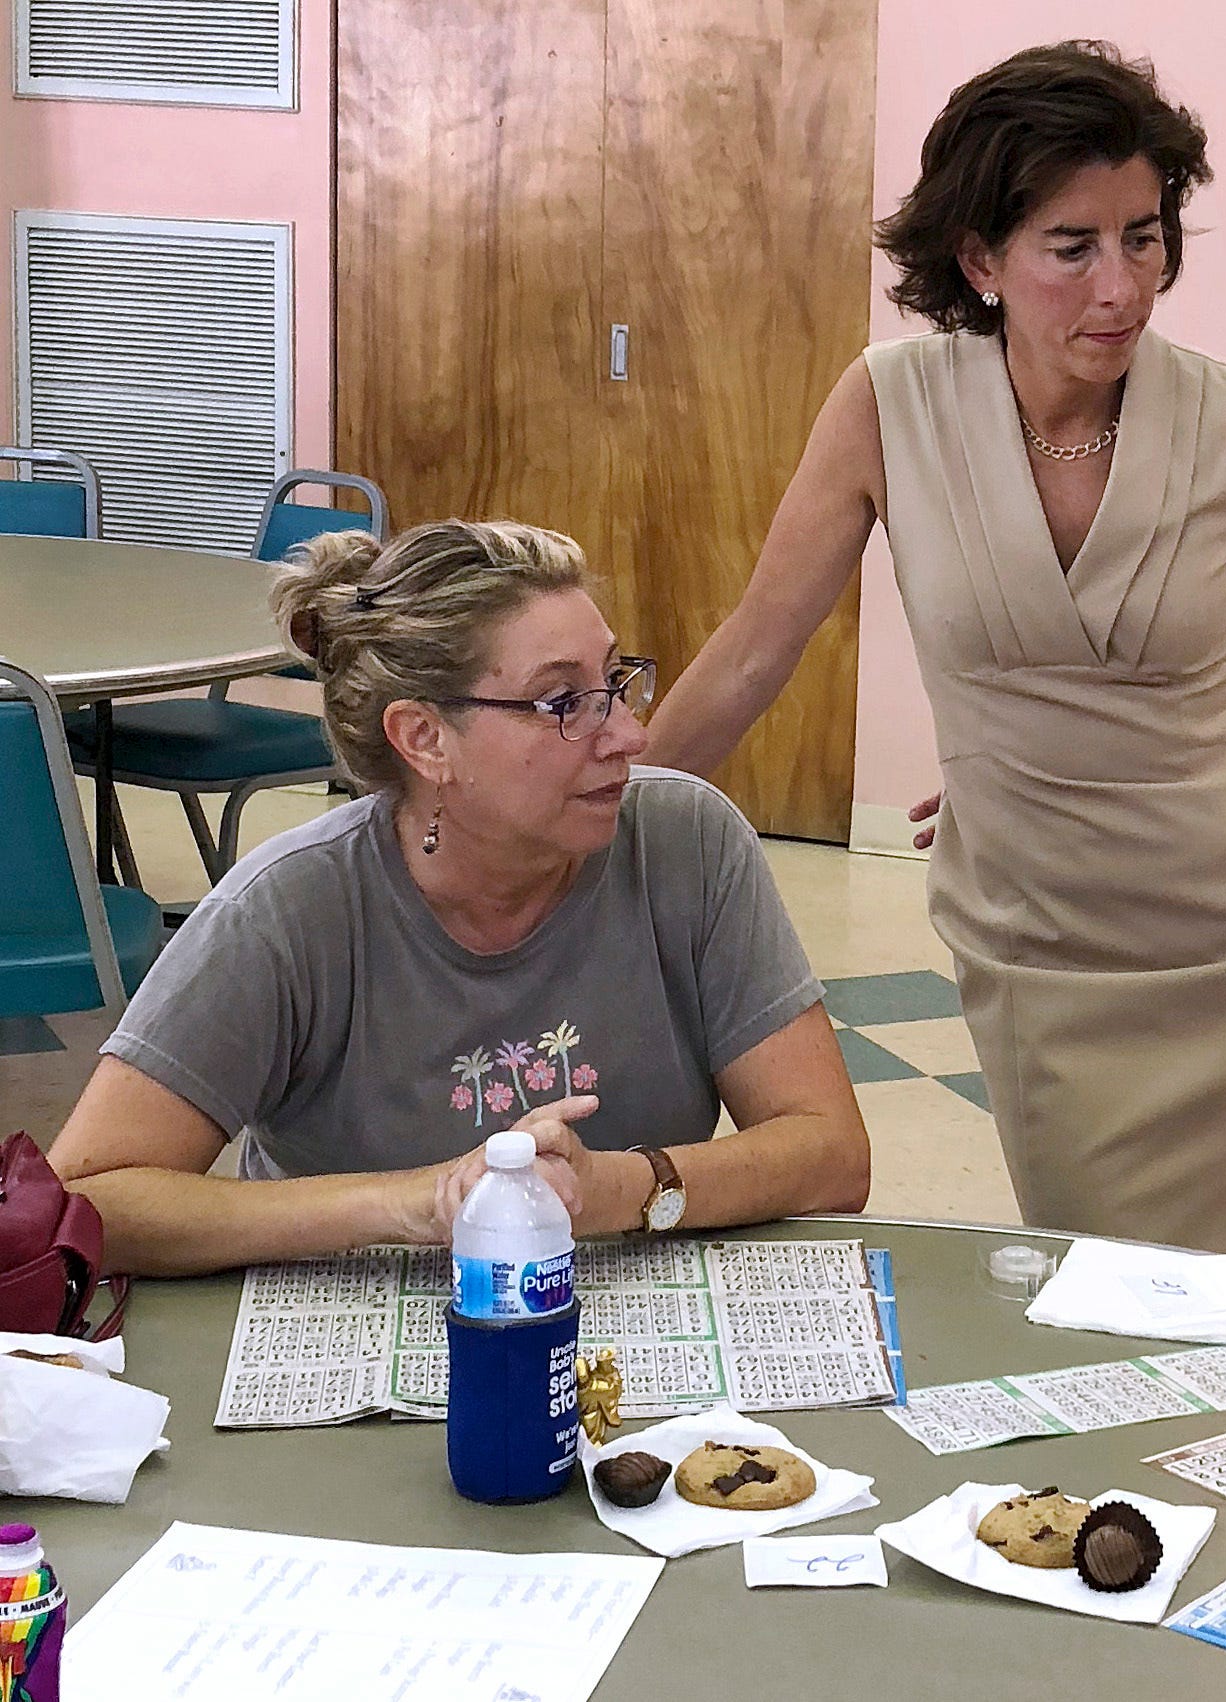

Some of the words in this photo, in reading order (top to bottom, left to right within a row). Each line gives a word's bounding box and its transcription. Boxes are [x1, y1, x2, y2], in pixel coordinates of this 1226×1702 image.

[524, 1274, 561, 1293] Pure
[1170, 1462, 1194, 1472] 11
[1192, 1455, 1216, 1465] 20
